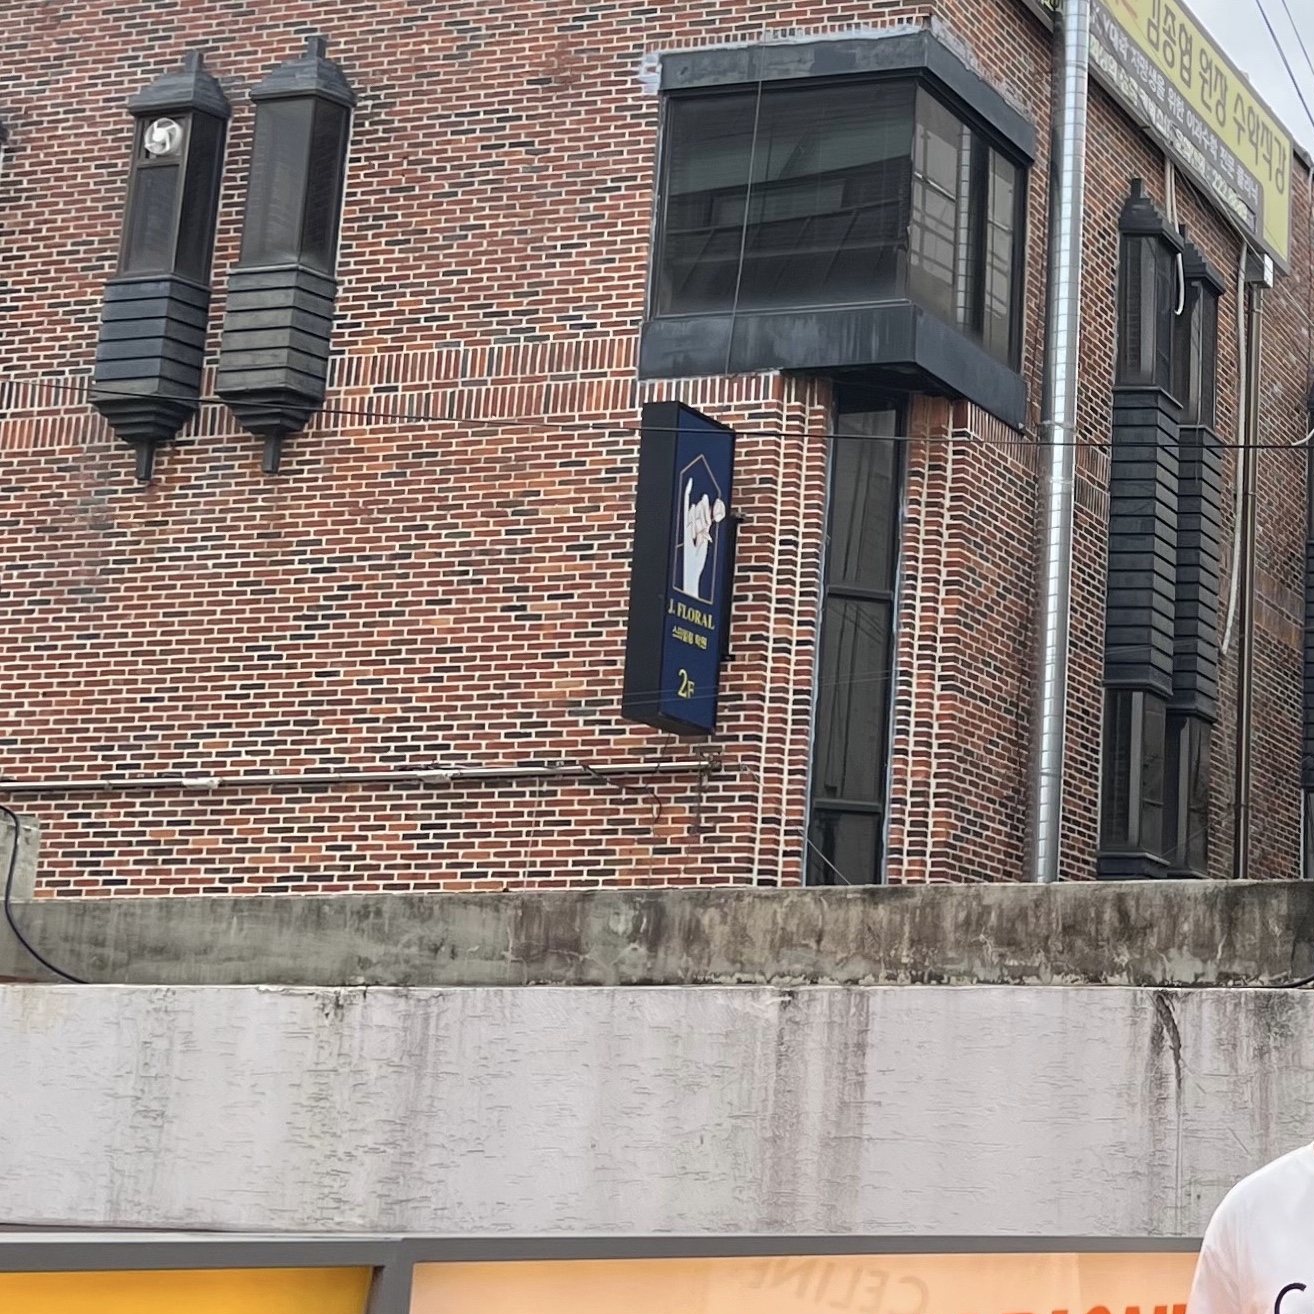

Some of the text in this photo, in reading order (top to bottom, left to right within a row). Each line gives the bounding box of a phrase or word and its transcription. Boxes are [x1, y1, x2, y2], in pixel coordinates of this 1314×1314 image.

[1199, 47, 1228, 128] 원장
[1168, 86, 1185, 126] 위한
[1220, 145, 1236, 180] 전문
[677, 601, 715, 630] FLORAL
[678, 668, 695, 699] 2F
